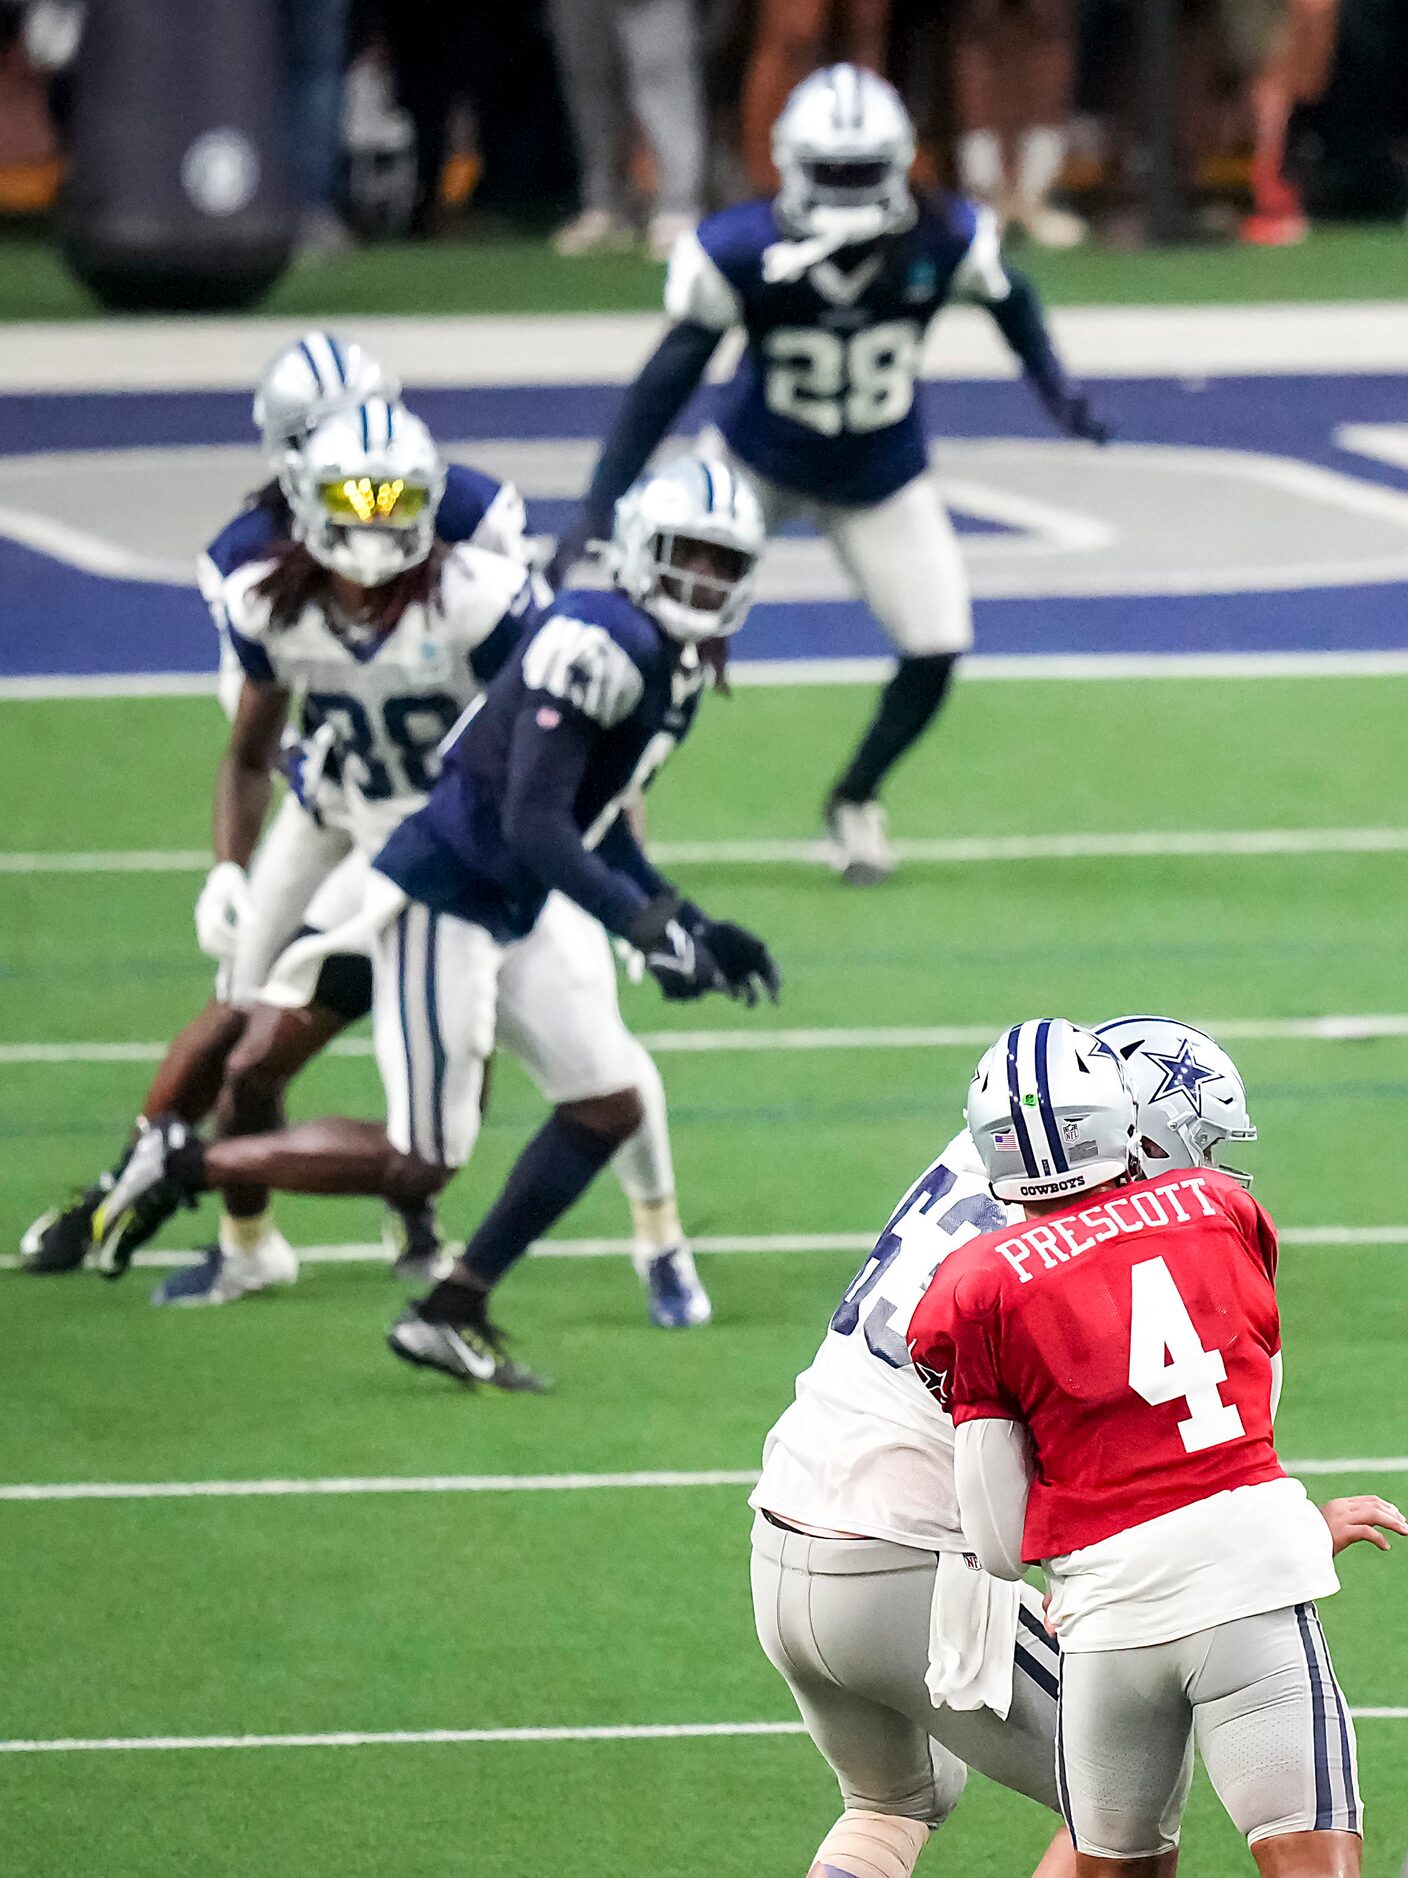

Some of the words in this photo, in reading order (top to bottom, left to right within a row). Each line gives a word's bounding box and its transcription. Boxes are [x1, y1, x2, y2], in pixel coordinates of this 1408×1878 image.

[762, 320, 915, 437] 28
[995, 1178, 1217, 1284] PRESCOTT
[1020, 1176, 1086, 1196] COWBOYS
[1128, 1255, 1246, 1454] 4
